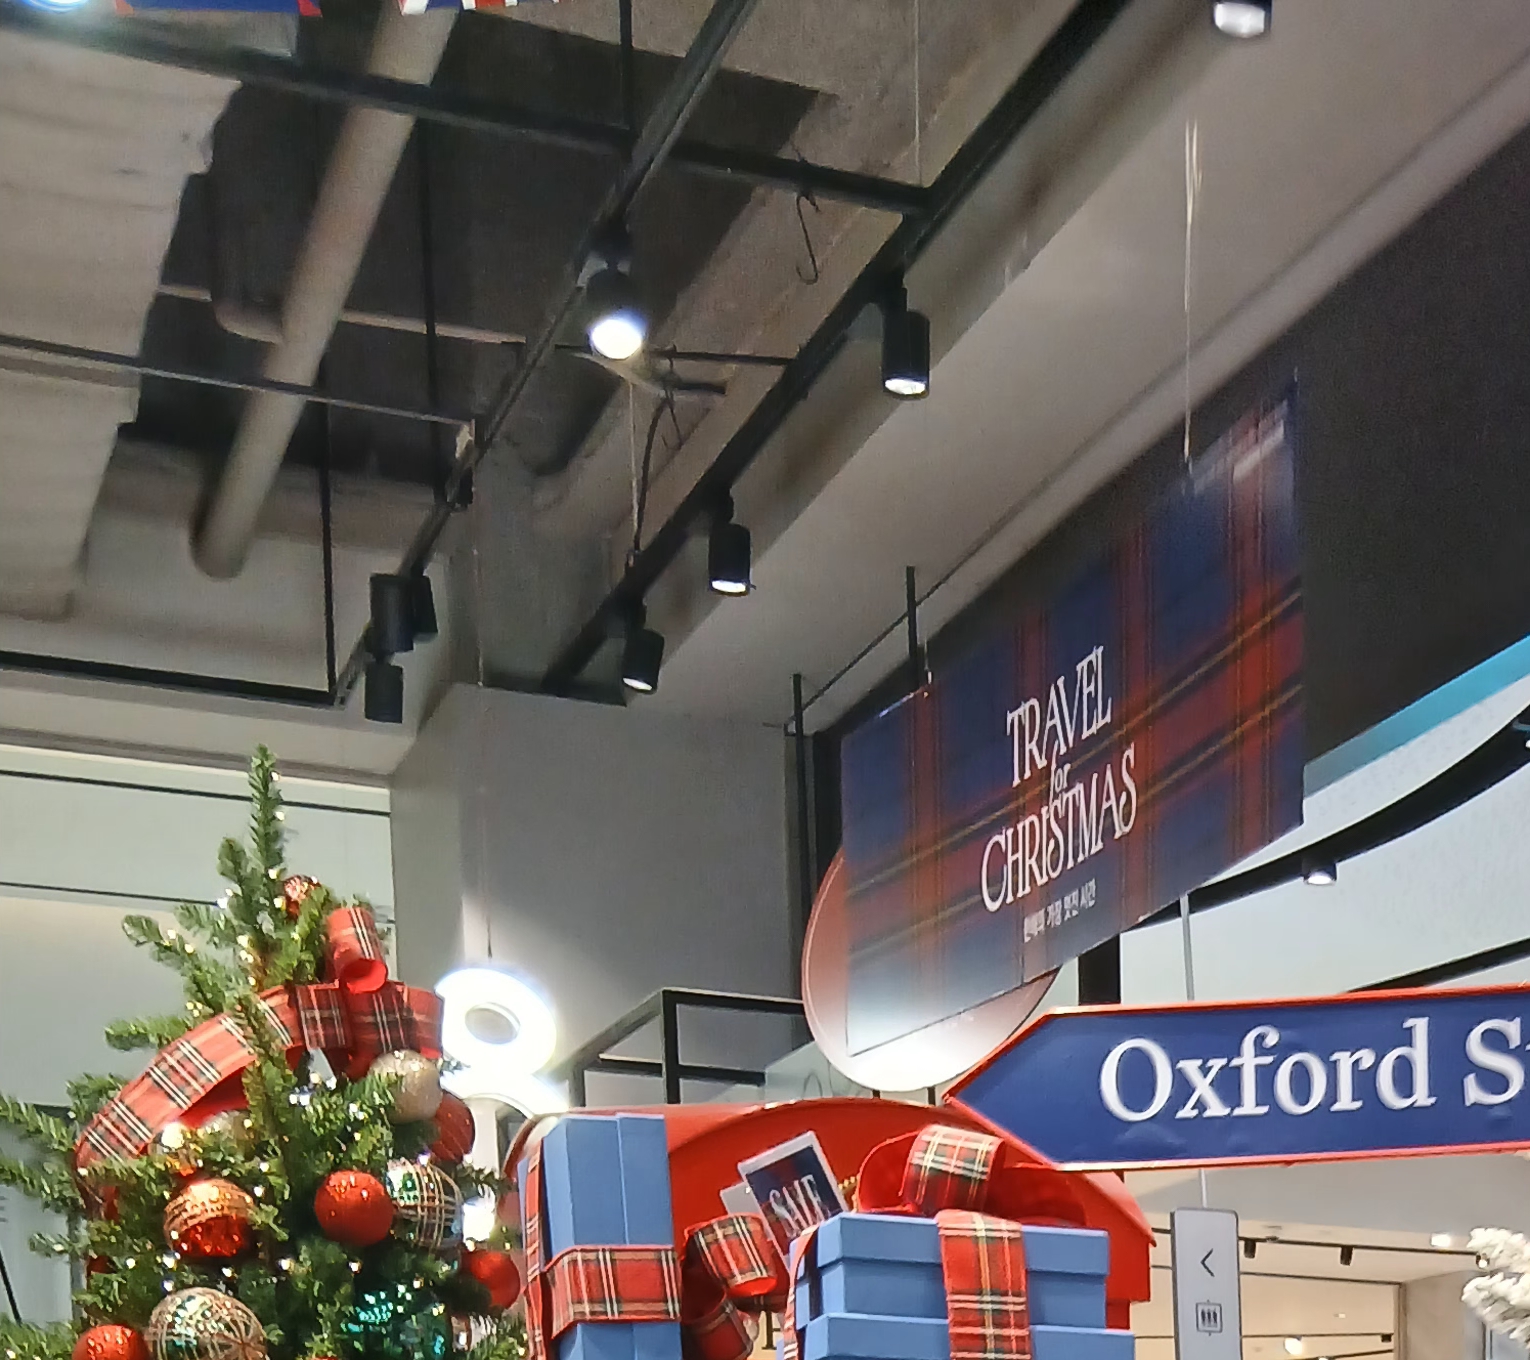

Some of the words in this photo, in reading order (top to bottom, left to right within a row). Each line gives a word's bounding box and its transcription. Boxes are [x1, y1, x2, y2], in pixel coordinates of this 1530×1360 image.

[1006, 645, 1112, 789] TRAVEL
[1050, 741, 1072, 805] for
[981, 742, 1137, 913] CHRISTMAS
[1098, 1016, 1438, 1123] Oxford
